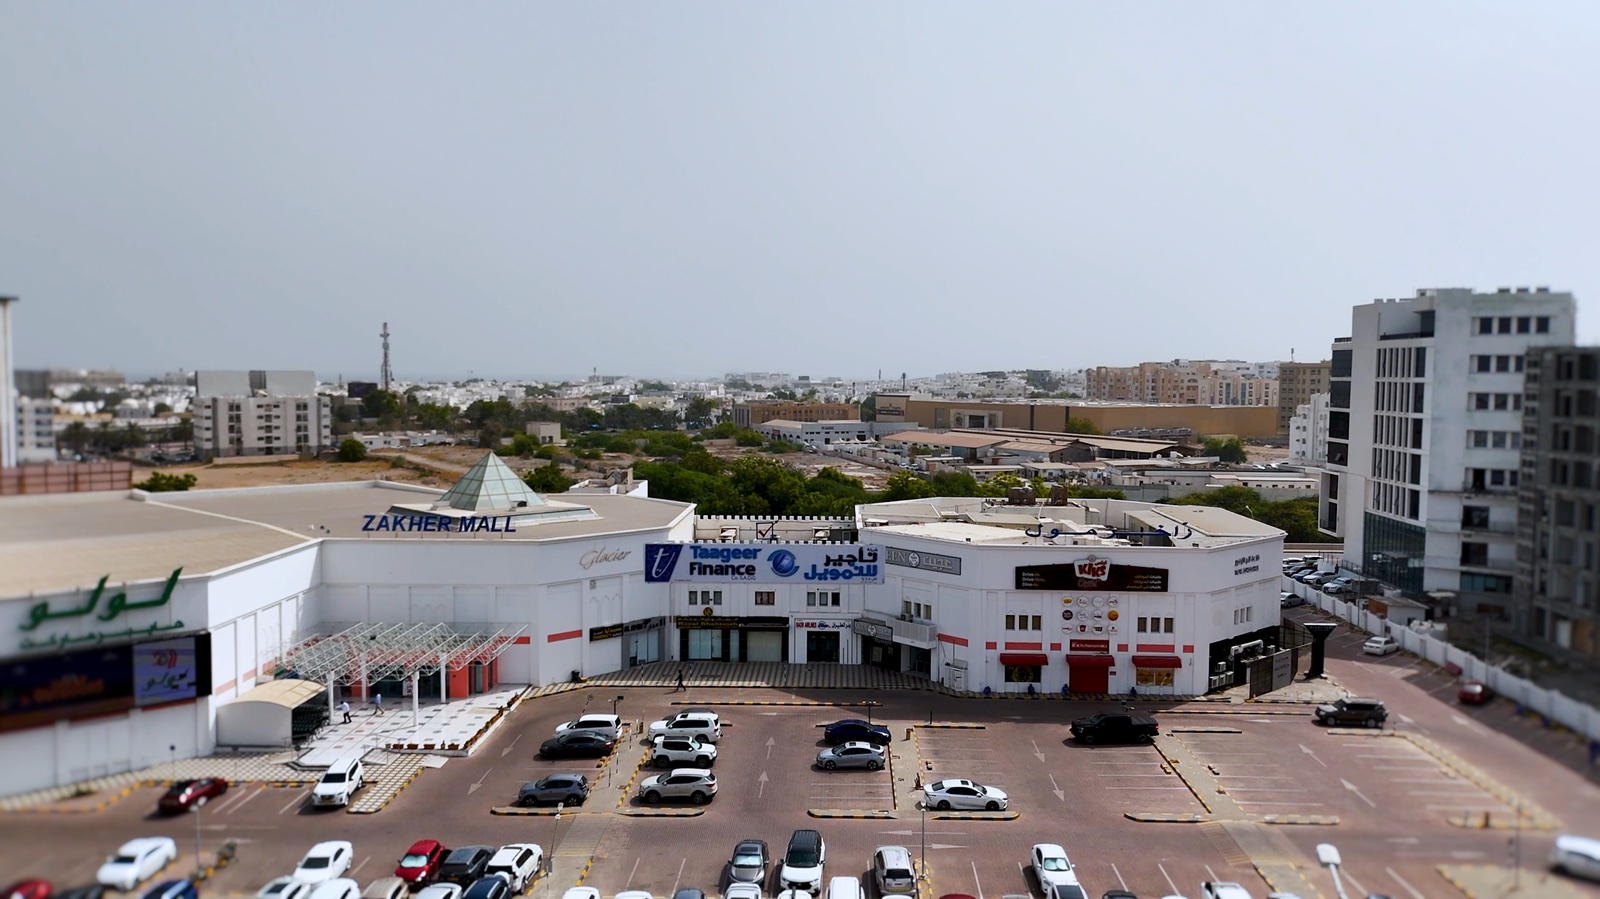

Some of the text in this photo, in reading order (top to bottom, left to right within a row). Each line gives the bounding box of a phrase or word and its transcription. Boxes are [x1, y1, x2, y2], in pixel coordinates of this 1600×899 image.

[362, 515, 517, 533] ZAKHER MALL
[1024, 522, 1098, 540] مول
[579, 547, 632, 570] Glacier
[690, 546, 762, 563] Taageer
[823, 546, 878, 567] تأجير
[689, 562, 756, 576] Finance
[803, 564, 878, 581] للتمويل
[19, 566, 184, 631] لولو
